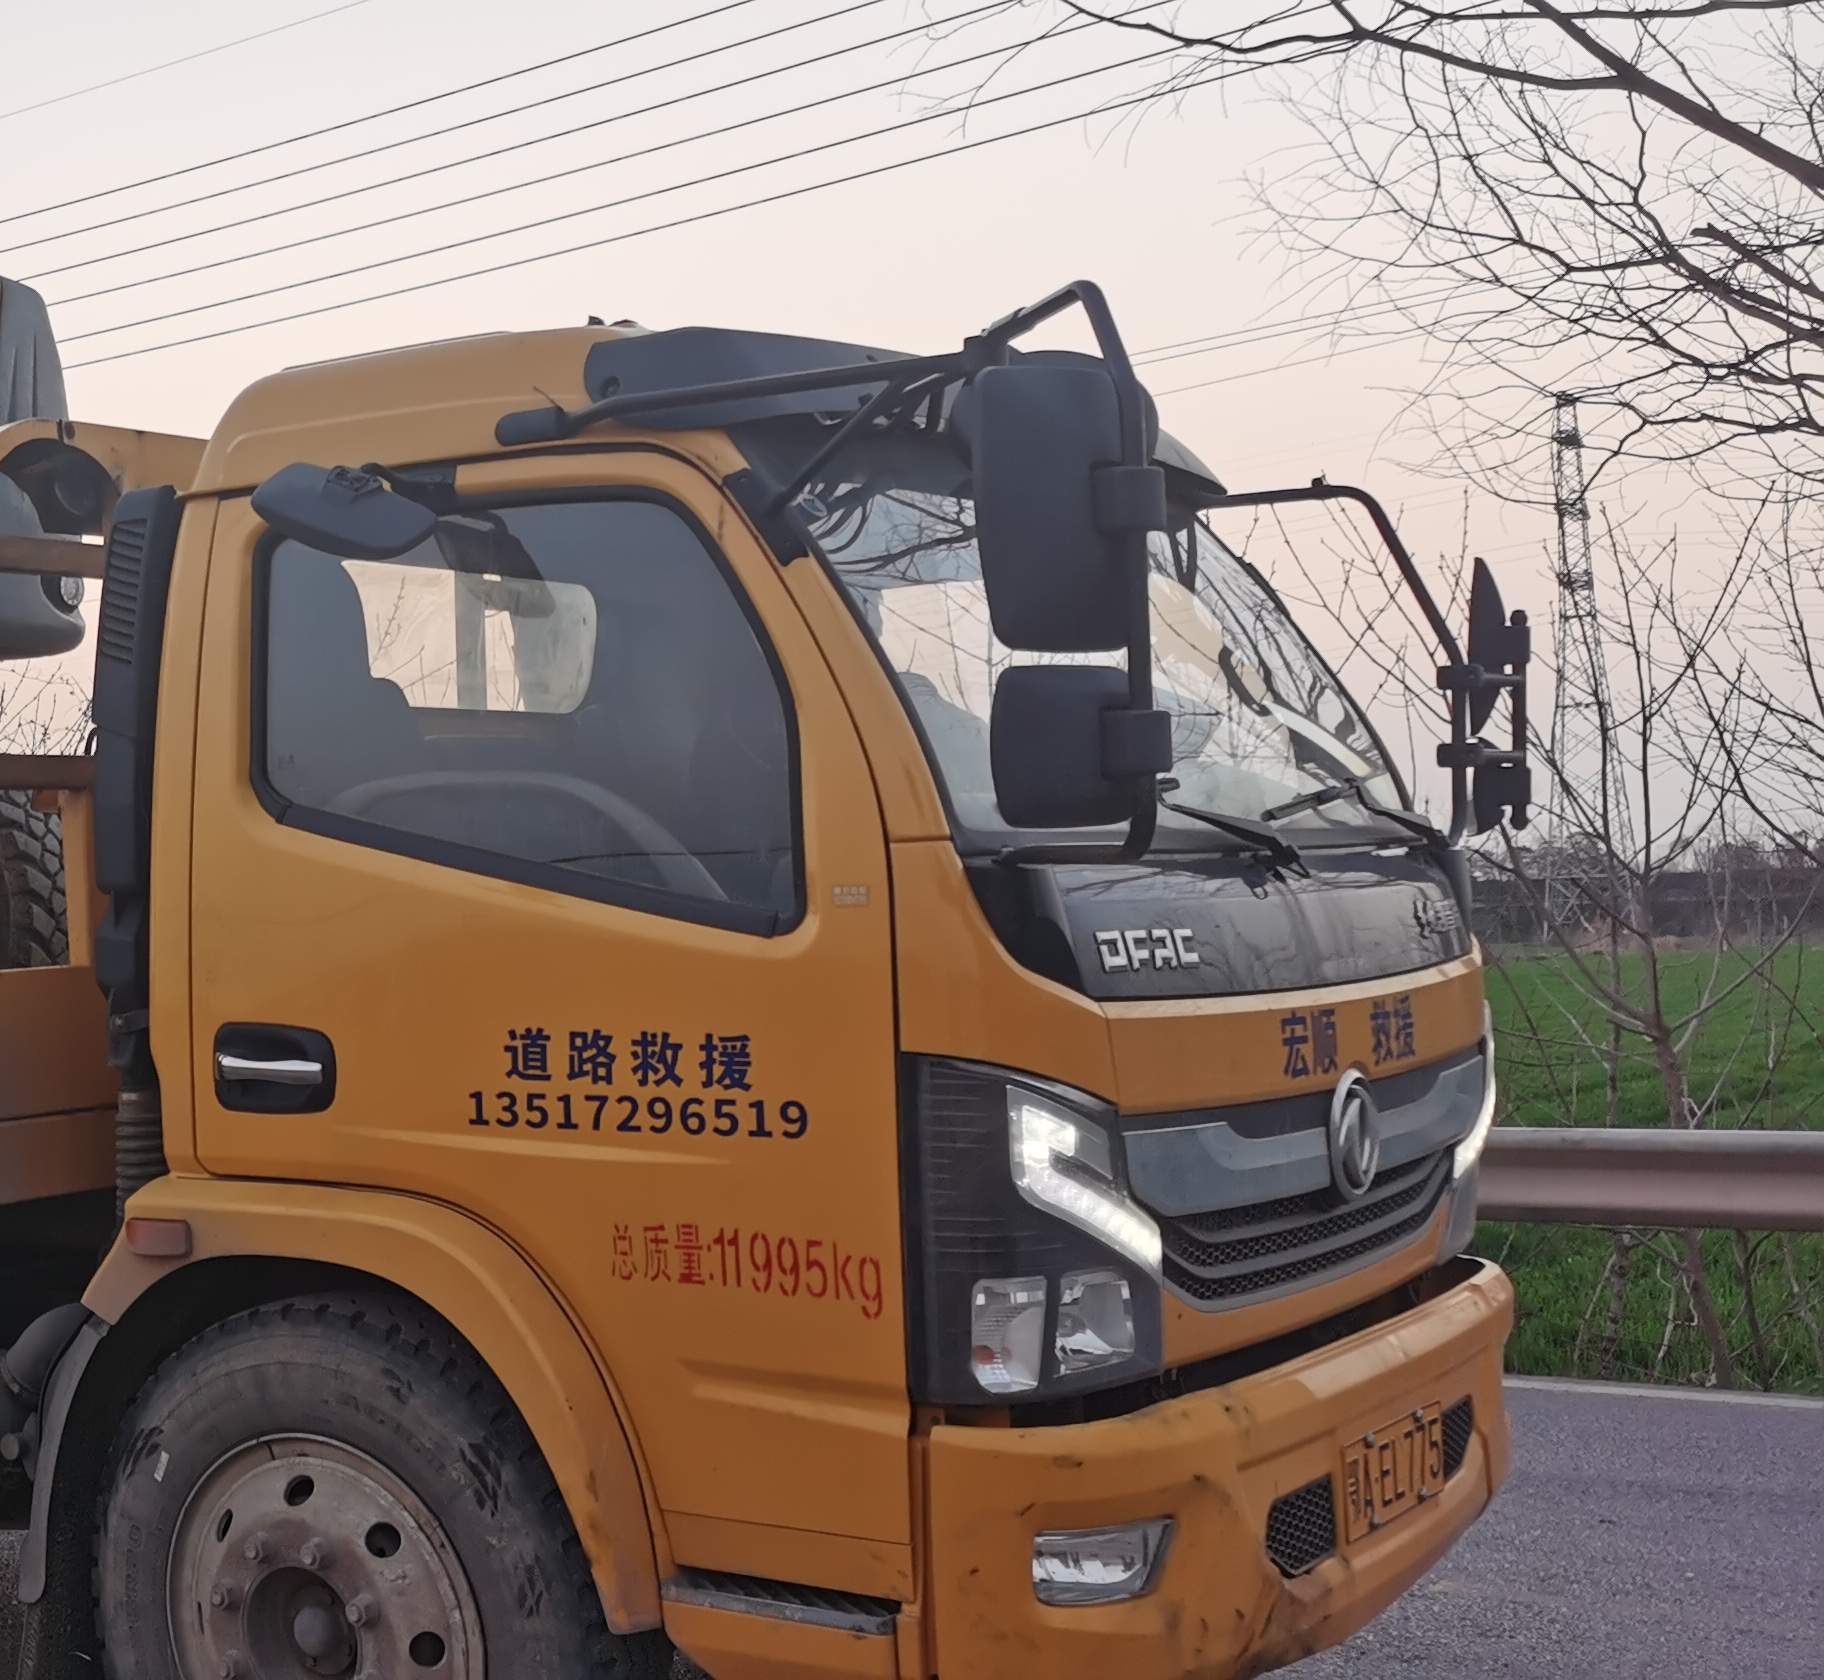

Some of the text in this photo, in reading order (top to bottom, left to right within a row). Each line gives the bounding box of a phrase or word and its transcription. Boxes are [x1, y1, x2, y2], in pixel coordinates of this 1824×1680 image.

[503, 1027, 754, 1092] 道路救援
[1280, 995, 1416, 1078] 宏顺 救援
[467, 1091, 810, 1140] 13517296519
